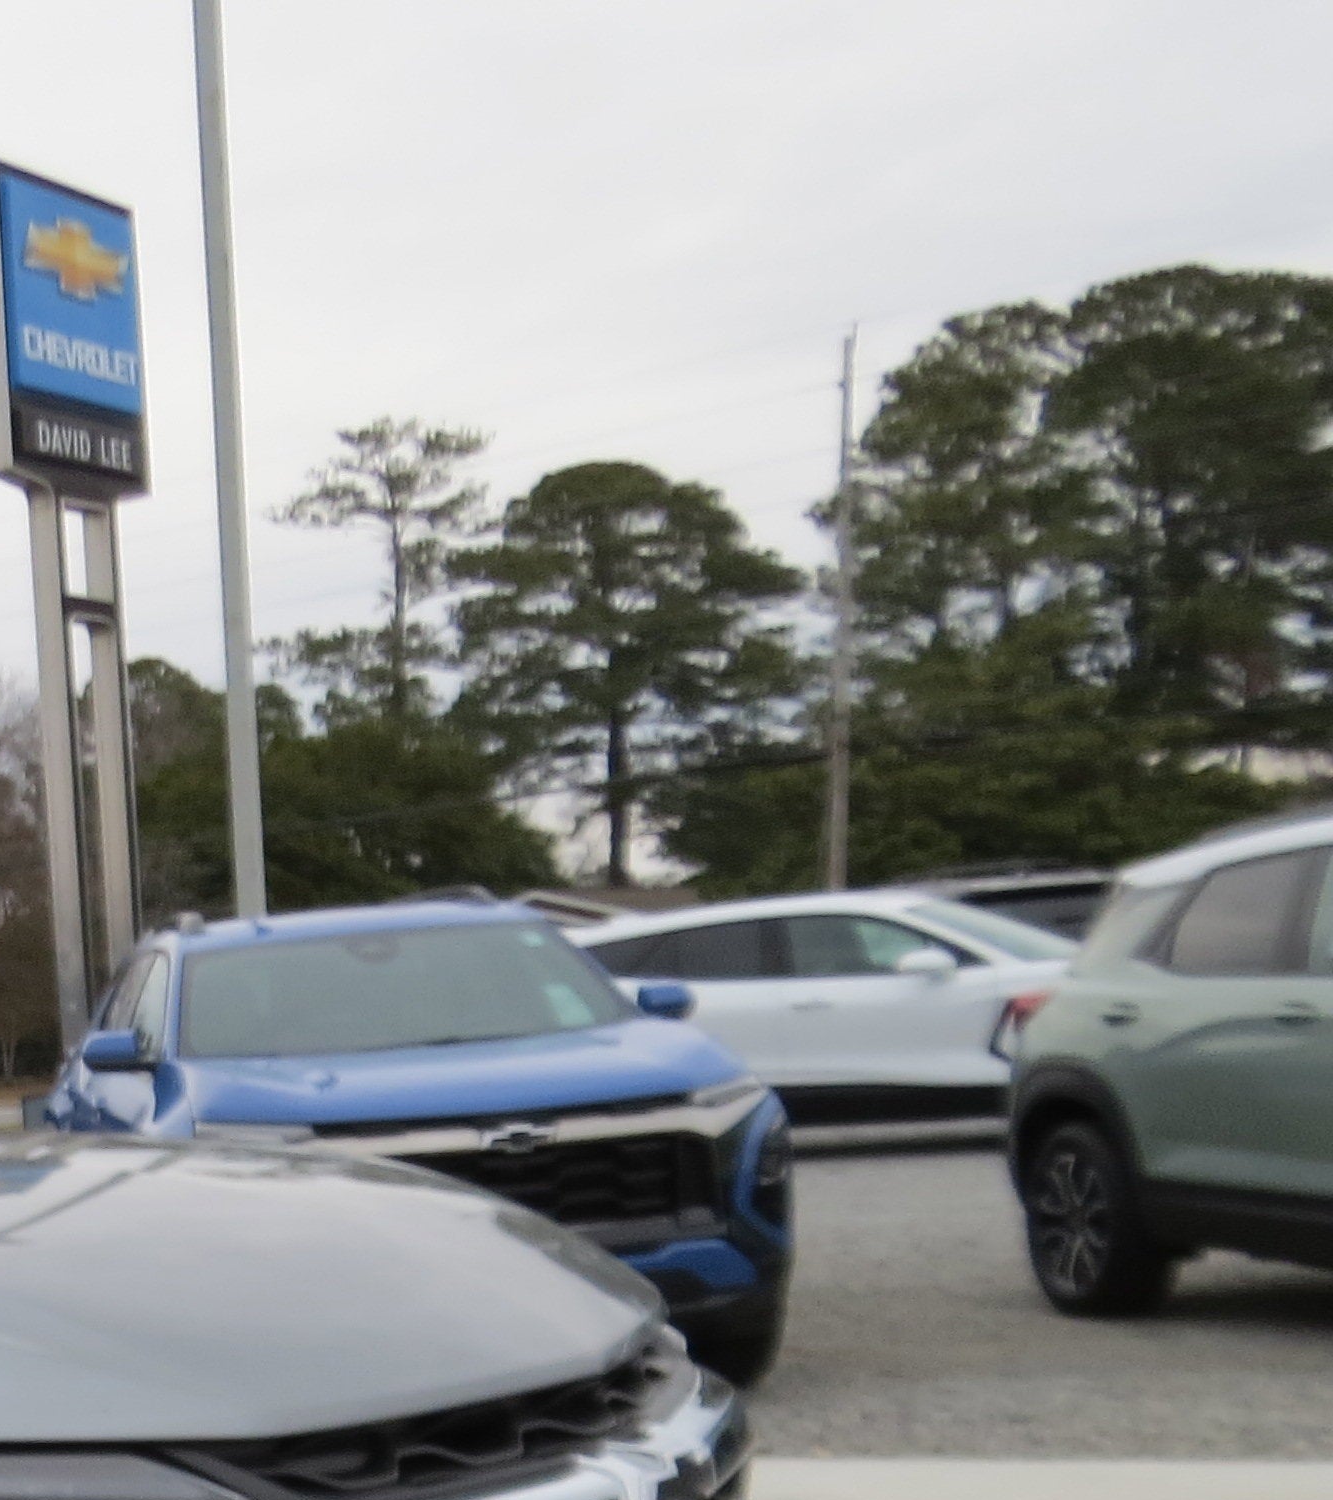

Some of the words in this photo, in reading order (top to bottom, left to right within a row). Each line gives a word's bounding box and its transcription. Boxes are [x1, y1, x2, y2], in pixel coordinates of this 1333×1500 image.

[23, 324, 138, 386] CHEVROLET
[37, 418, 90, 462] DAVID
[100, 435, 132, 472] LEE
